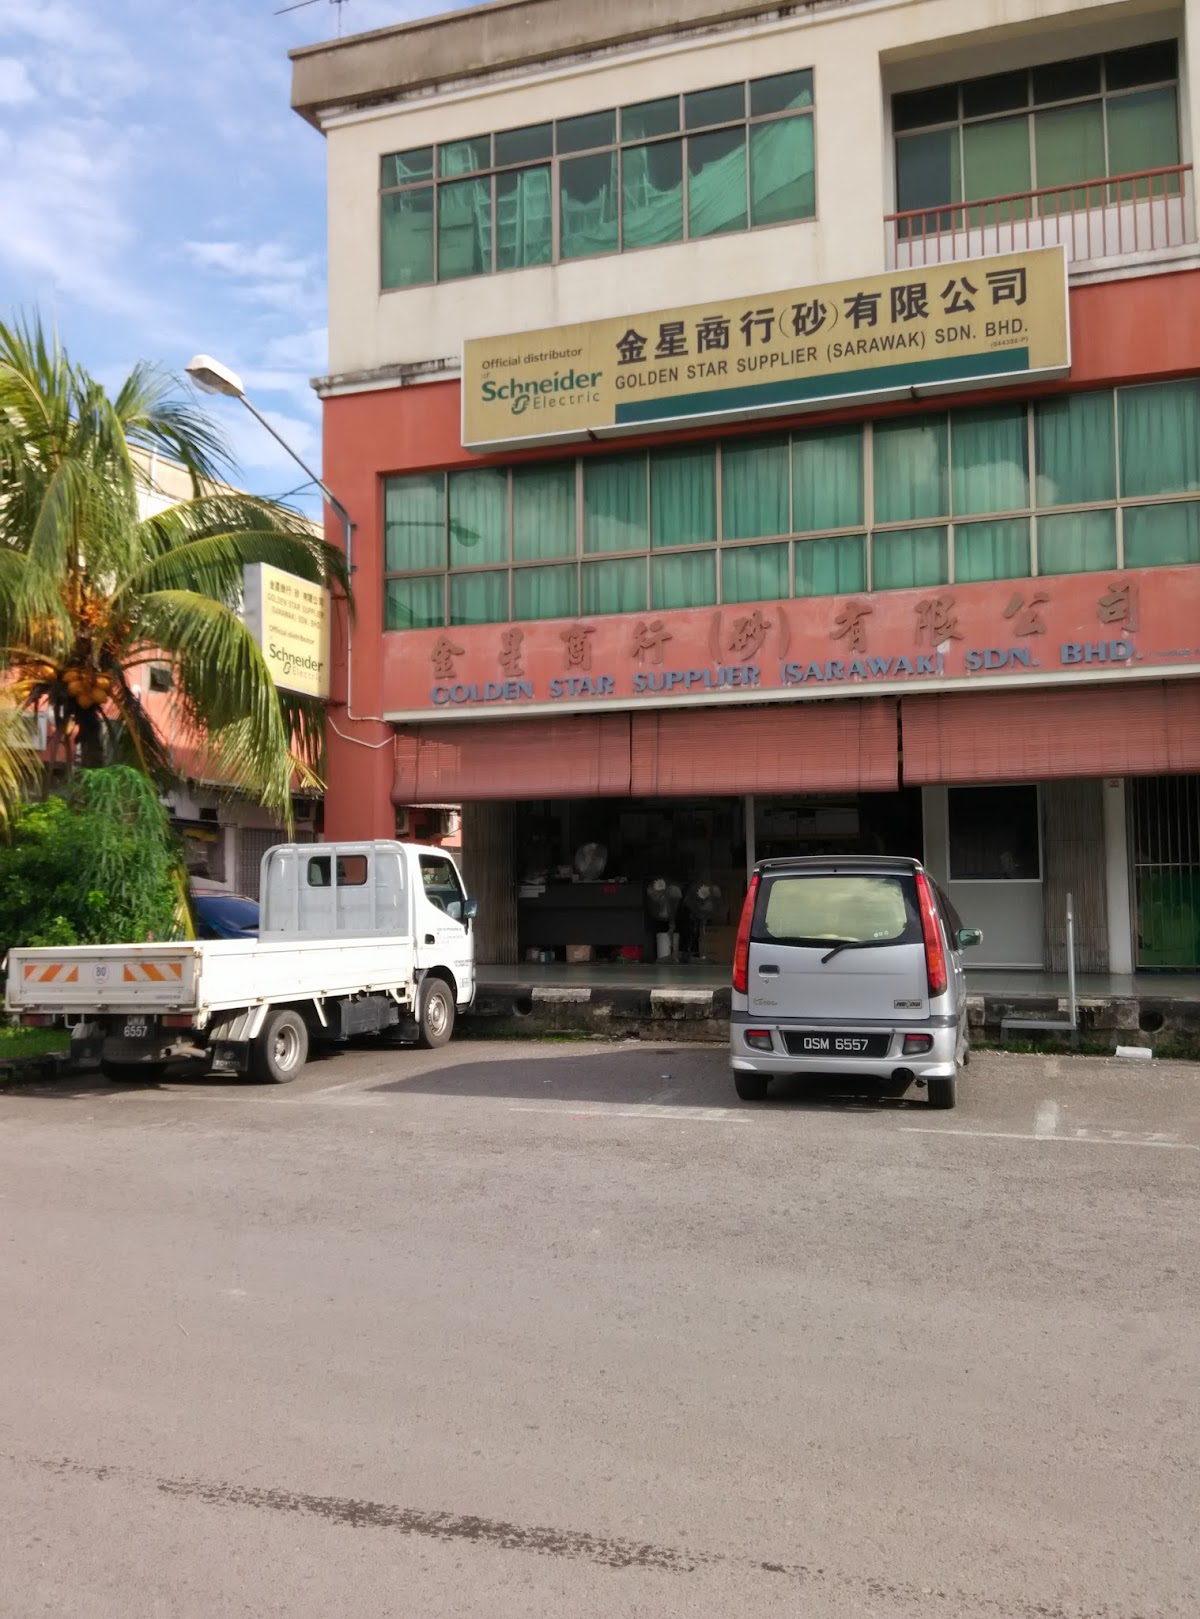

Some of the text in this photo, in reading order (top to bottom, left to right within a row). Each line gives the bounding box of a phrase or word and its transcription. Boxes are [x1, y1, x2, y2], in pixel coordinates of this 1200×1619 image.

[616, 267, 1027, 366] 金星商行(砂)有限公司
[481, 348, 583, 370] Official distributor
[615, 318, 1029, 390] GOLDEN STAR SUPPLIER (SARAWAK) SDN. BHD.
[481, 369, 603, 402] Schneider
[533, 391, 601, 410] Electric
[269, 643, 323, 672] Schneider
[431, 680, 534, 706] GOLDEN
[549, 674, 615, 698] STAR
[633, 664, 760, 693] SUPPLIER
[780, 651, 944, 684] (SARAWAK)
[964, 645, 1041, 671] SDN.
[1060, 638, 1144, 666] BHD.
[123, 1025, 148, 1037] 6557
[803, 1037, 869, 1051] QSM 6557
